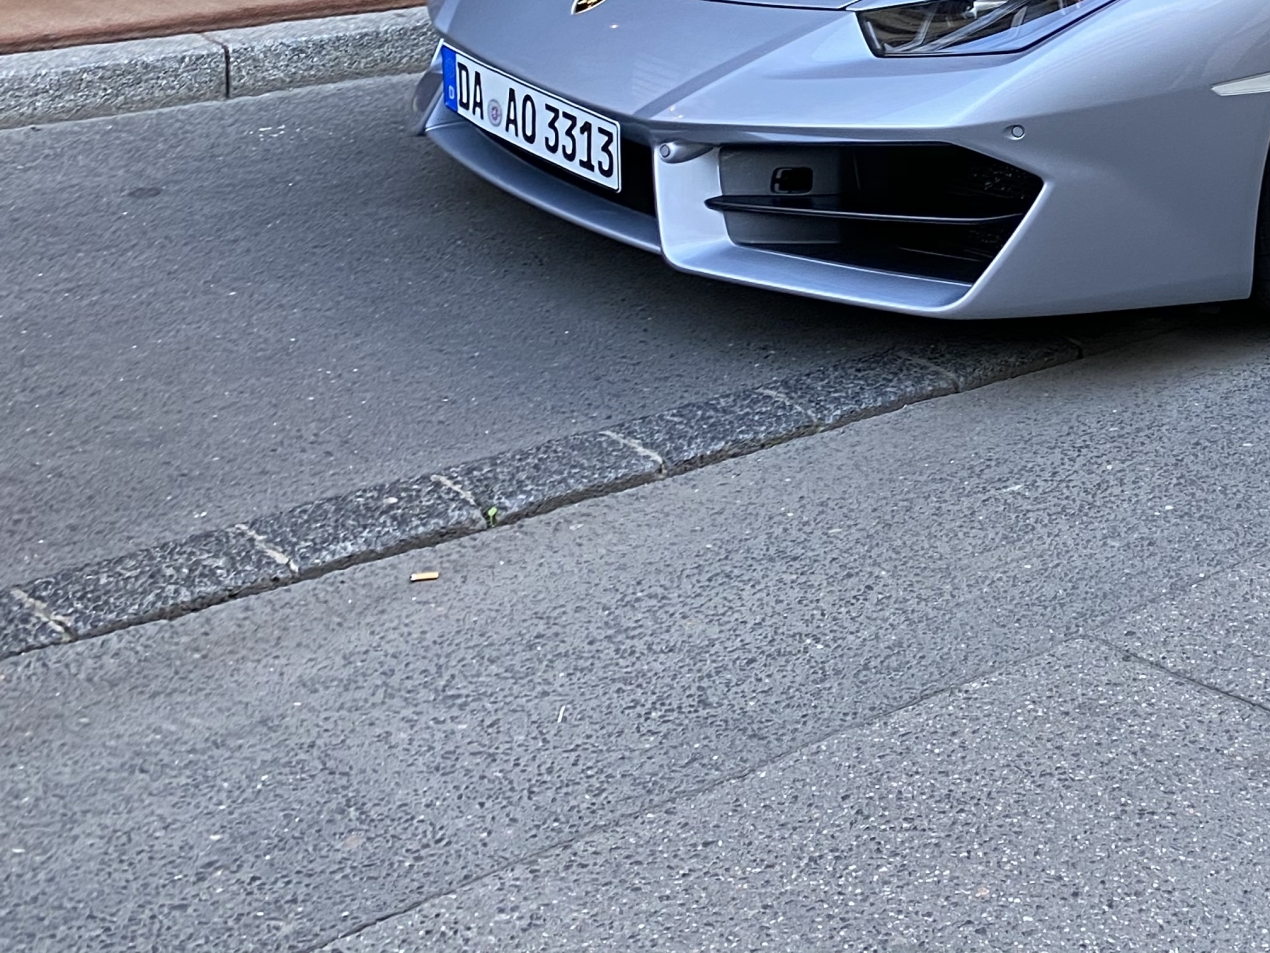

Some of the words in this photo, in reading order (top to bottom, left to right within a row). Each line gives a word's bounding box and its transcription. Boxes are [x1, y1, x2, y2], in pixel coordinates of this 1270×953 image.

[448, 85, 455, 99] D
[457, 62, 484, 120] DA
[505, 88, 537, 145] AO
[545, 103, 614, 178] 3313
